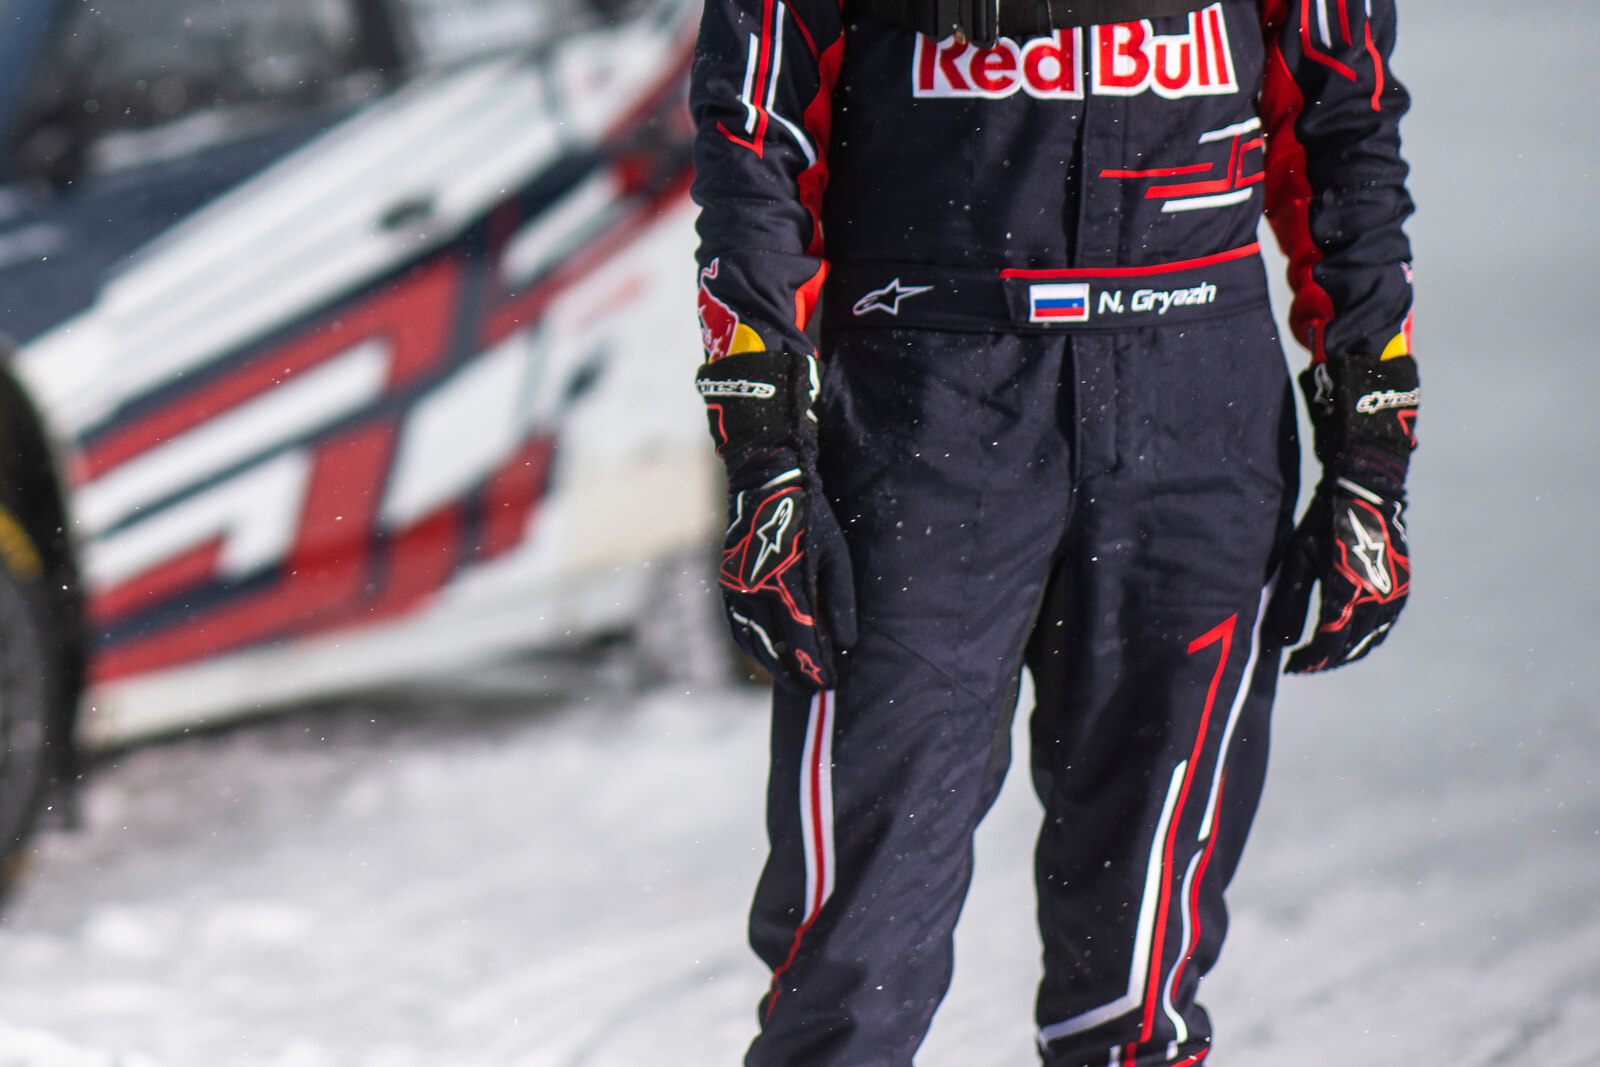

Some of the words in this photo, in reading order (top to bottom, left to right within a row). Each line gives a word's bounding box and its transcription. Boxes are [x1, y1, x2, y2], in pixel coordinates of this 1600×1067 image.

[912, 26, 1085, 99] Red
[1090, 2, 1239, 99] Bull
[1097, 290, 1124, 314] N.
